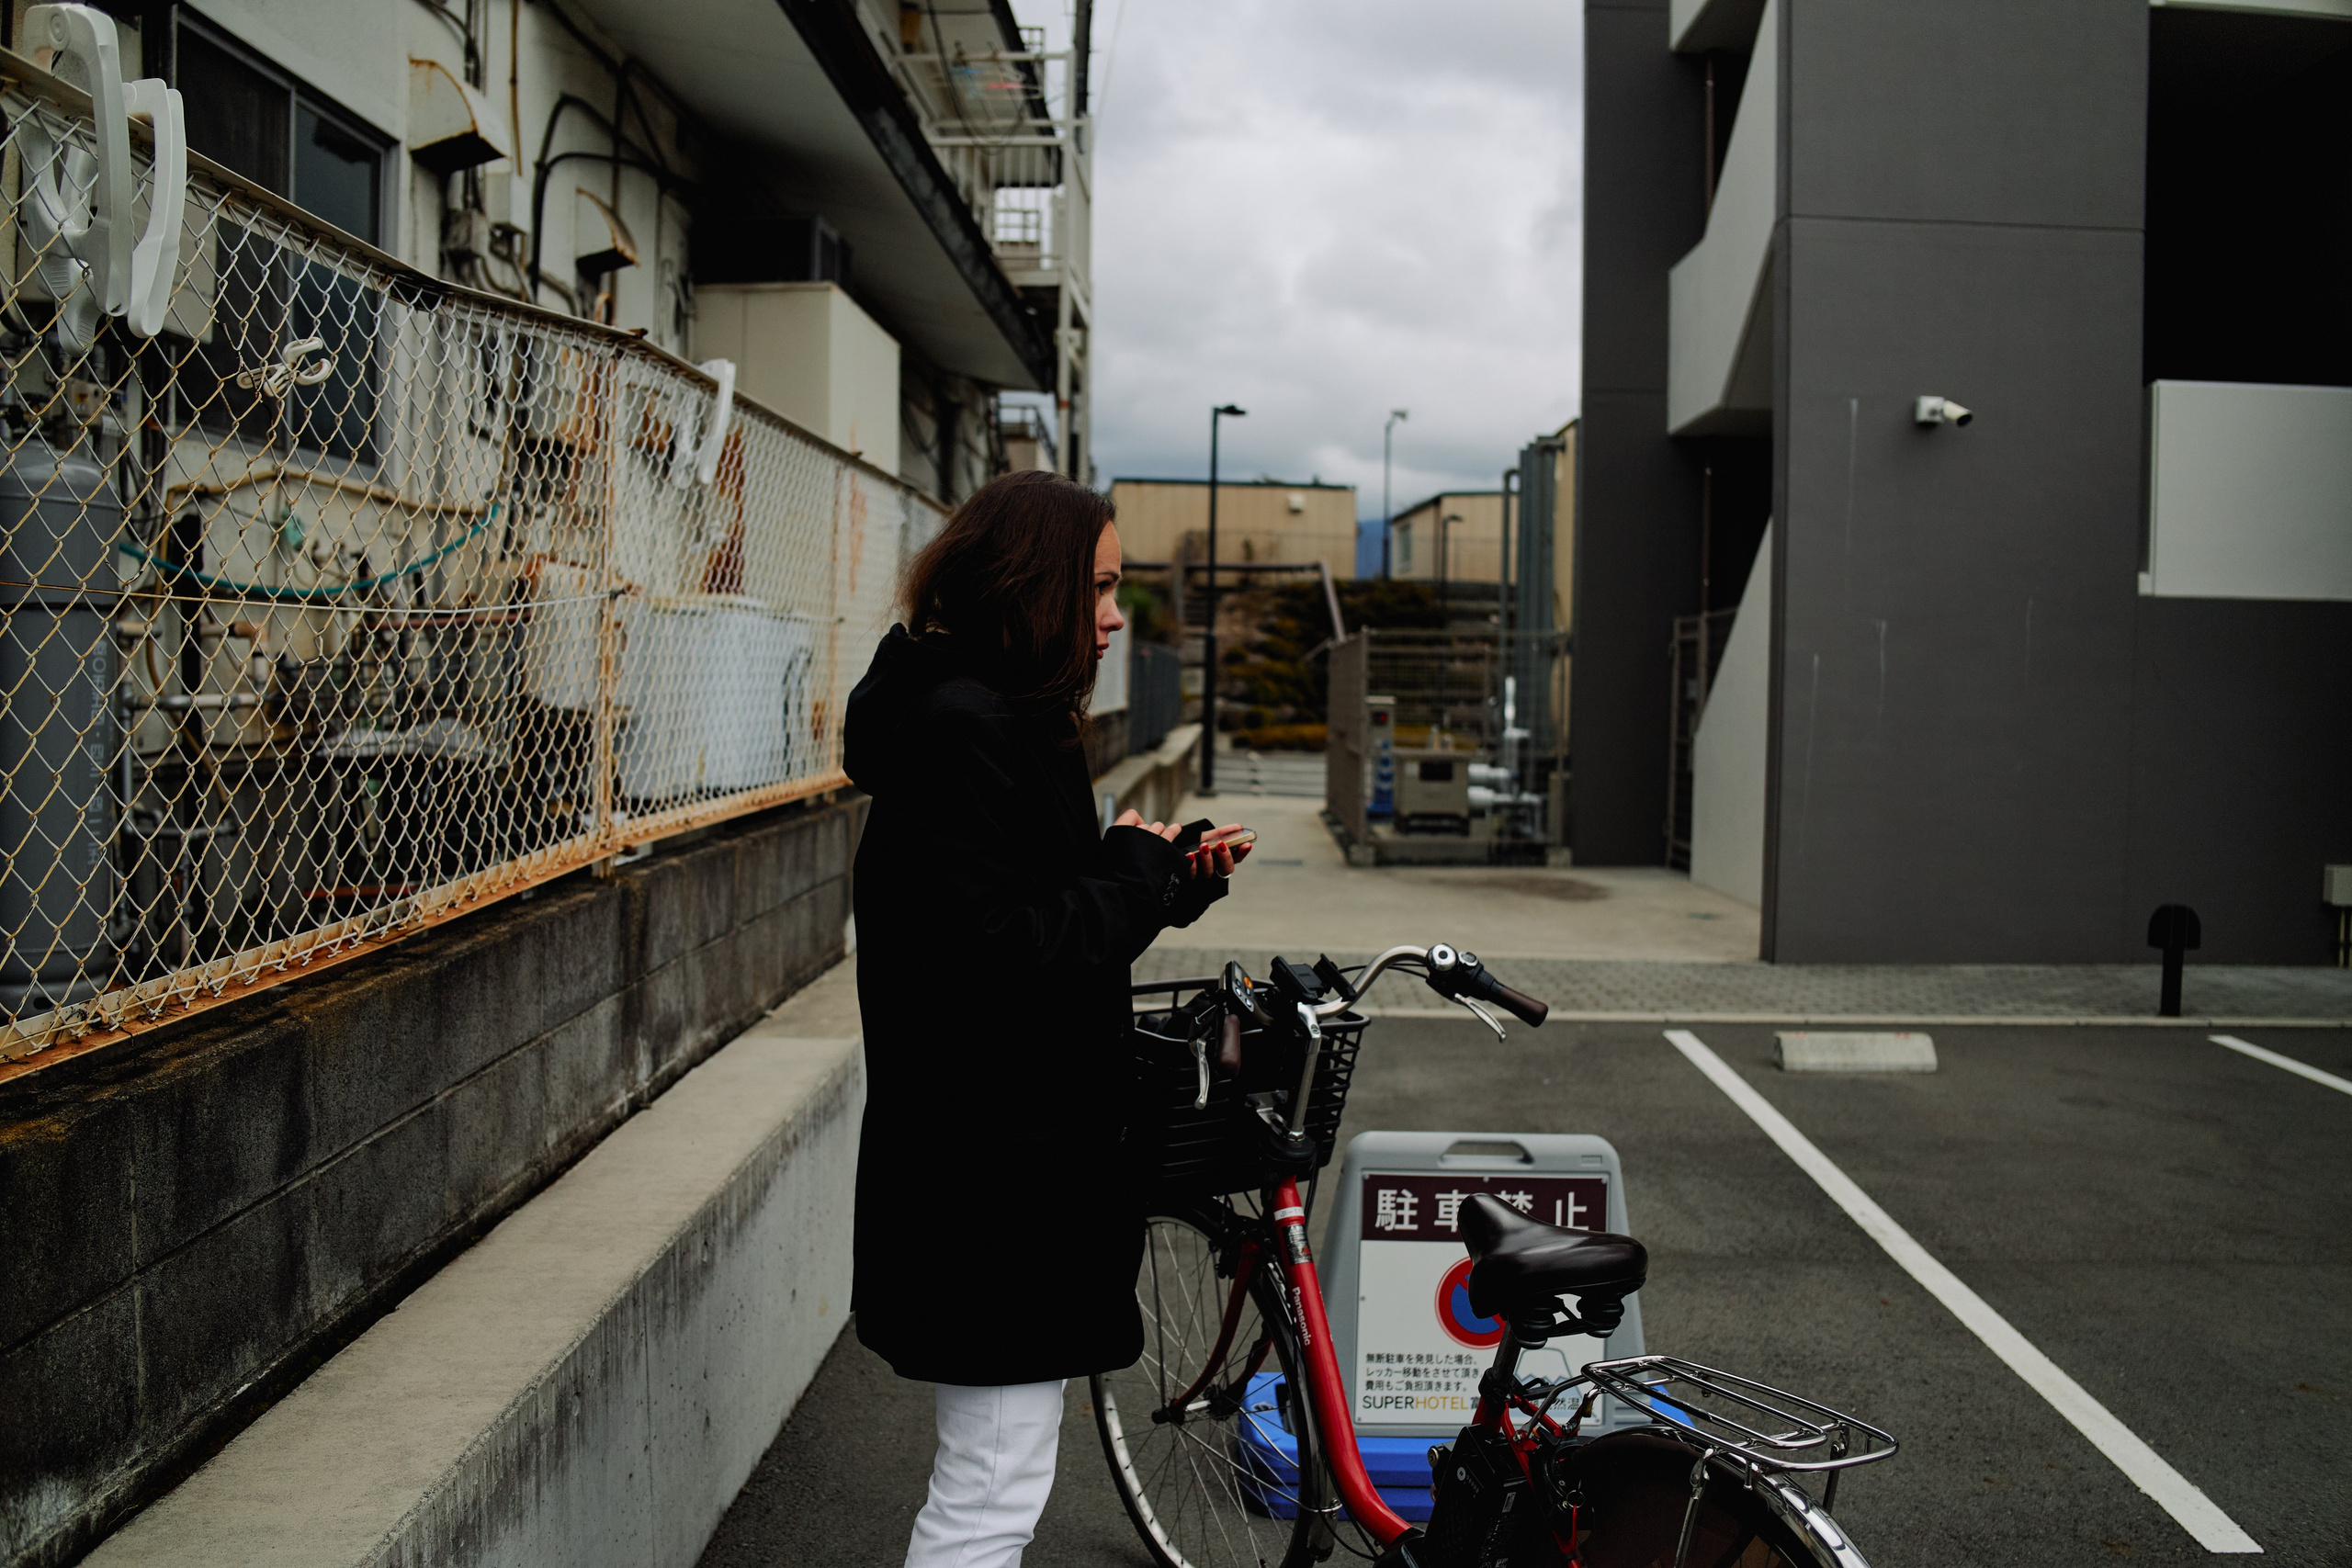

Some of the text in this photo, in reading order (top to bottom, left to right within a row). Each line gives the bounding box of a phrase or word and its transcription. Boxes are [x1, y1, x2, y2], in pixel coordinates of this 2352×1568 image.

[1292, 1286, 1312, 1347] Panasonic
[1364, 1380, 1468, 1392] 費用もご負担頂きます。
